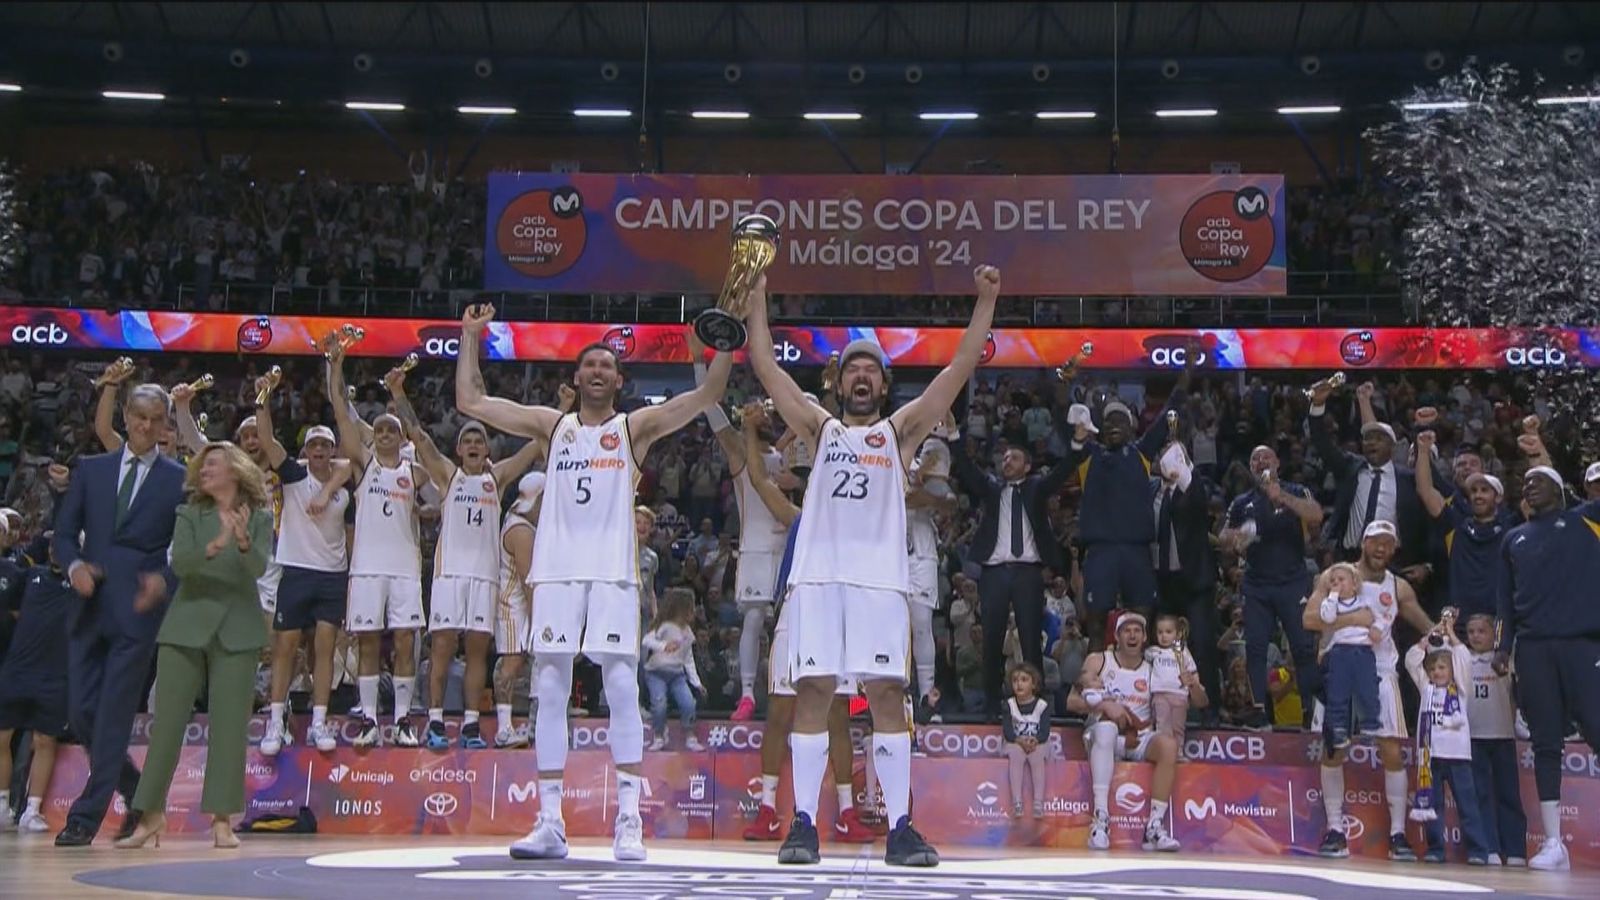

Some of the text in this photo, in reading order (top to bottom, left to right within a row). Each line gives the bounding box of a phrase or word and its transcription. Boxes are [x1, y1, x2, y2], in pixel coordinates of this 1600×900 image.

[522, 216, 546, 226] acb
[614, 197, 1152, 231] CAMPEONES COPA DEL REY
[1206, 217, 1231, 227] acb
[513, 224, 558, 240] Copa
[1197, 226, 1244, 242] Copa
[789, 238, 972, 271] Málaga '24
[11, 323, 68, 345] acb
[425, 335, 462, 355] ac
[1506, 342, 1566, 365] acb
[556, 459, 626, 472] AUTOHERO
[825, 451, 893, 469] AUTOHERO
[576, 476, 592, 505] 5
[832, 470, 870, 500] 23
[467, 507, 484, 526] 14
[1475, 684, 1489, 699] 13
[351, 769, 394, 785] Unicaja
[409, 766, 476, 782] endesa
[562, 786, 591, 798] vistar
[335, 799, 382, 815] IONOS
[1224, 803, 1278, 817] Movistar
